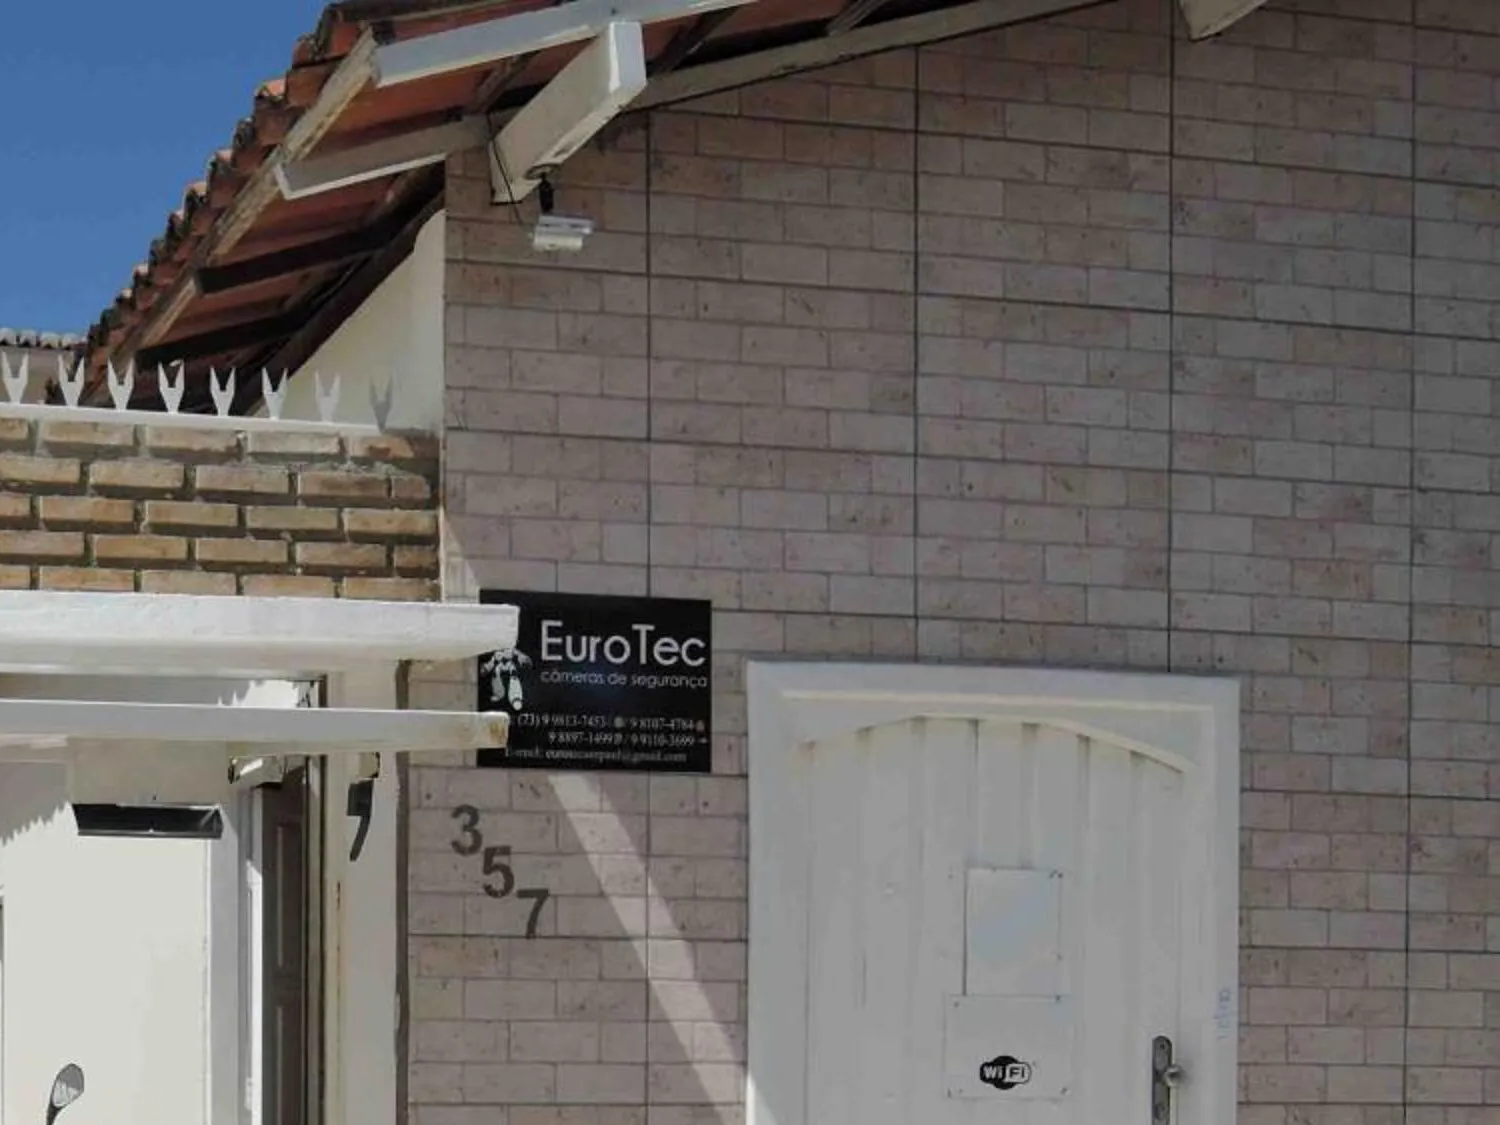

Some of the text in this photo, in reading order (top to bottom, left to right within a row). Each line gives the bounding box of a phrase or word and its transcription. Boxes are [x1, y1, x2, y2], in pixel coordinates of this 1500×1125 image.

[541, 620, 706, 667] EuroTec
[540, 670, 708, 689] câmeras de segurança
